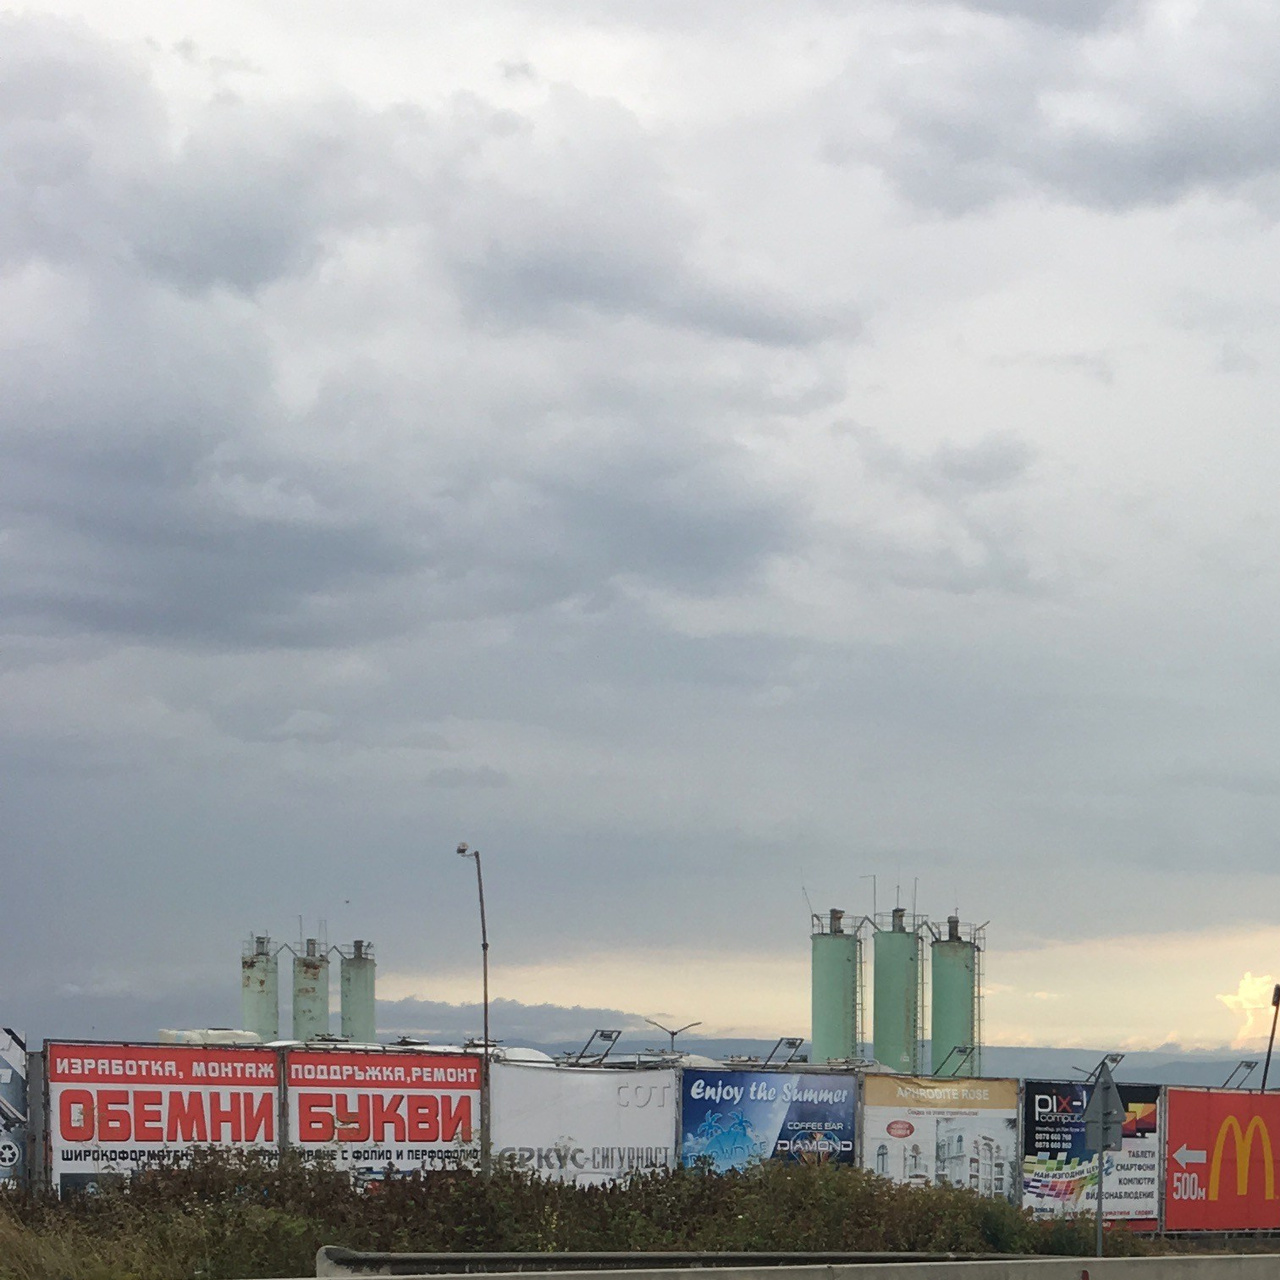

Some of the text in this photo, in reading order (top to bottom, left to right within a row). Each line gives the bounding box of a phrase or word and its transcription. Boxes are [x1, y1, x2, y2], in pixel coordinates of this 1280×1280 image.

[56, 1058, 275, 1079] ИЗРАБОТКА, МОНТАЖ
[690, 1079, 848, 1105] Enjoy the Summer
[896, 1086, 990, 1100] APHRODITE ROSE
[59, 1088, 274, 1142] ОБЕМНИ
[299, 1093, 473, 1143] БУКВИ
[787, 1121, 844, 1130] COFFEE BAR
[777, 1140, 853, 1151] DIAMOND
[342, 1150, 348, 1161] С
[352, 1150, 392, 1161] ФОЛИО
[396, 1150, 404, 1161] И
[1128, 1150, 1155, 1158] ТАБЛЕТИ
[1086, 1165, 1099, 1174] ЦЕН
[1116, 1163, 1155, 1171] СМАРТФОНИ
